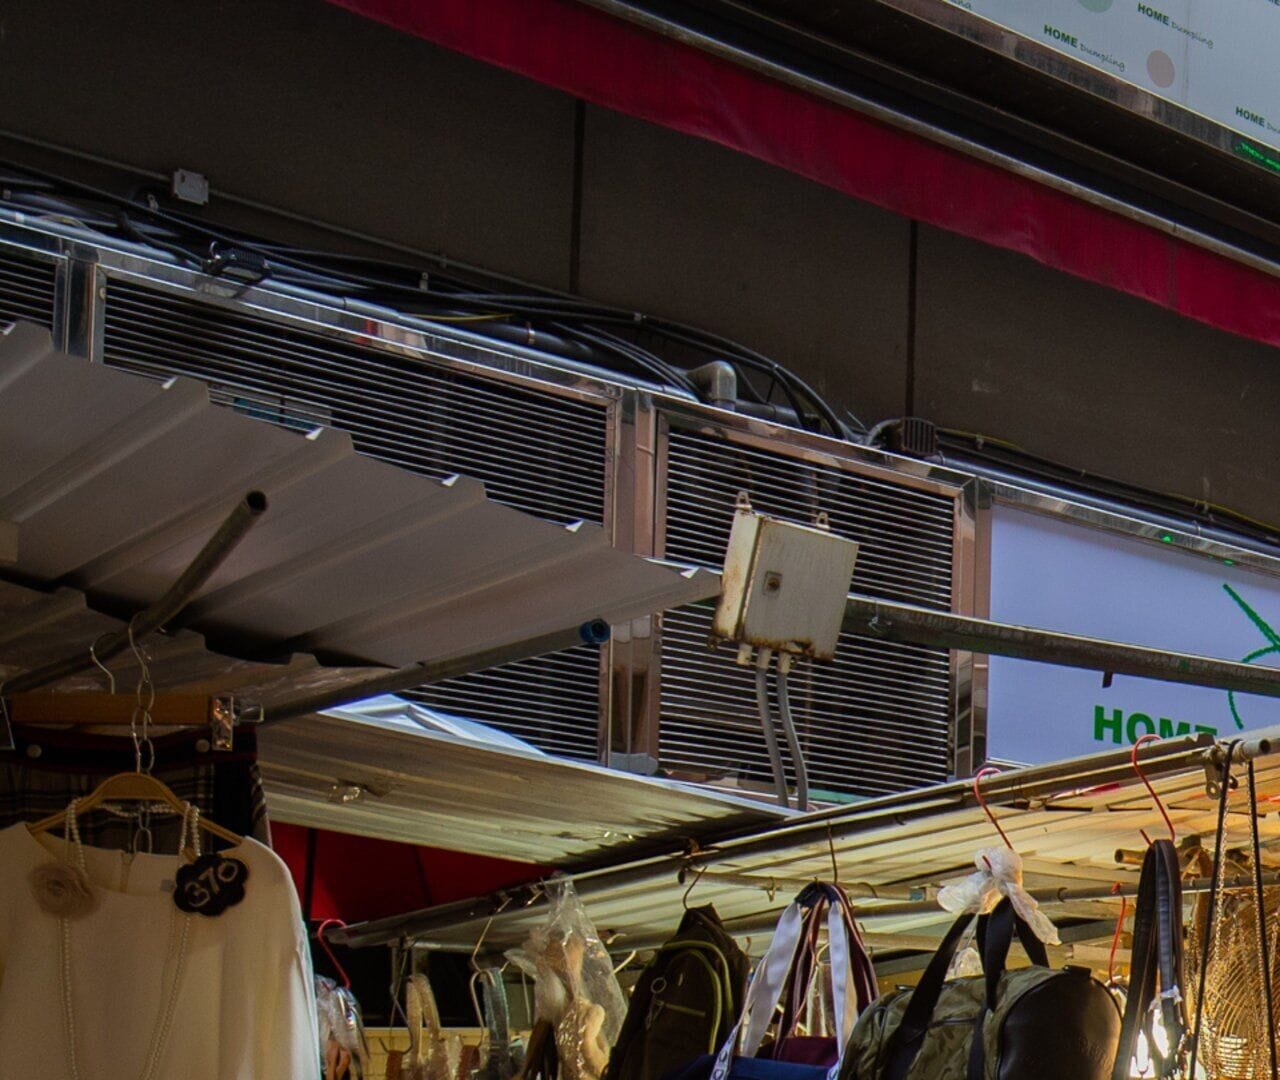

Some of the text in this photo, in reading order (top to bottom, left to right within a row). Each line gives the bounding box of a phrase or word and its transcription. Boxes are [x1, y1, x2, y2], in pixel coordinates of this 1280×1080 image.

[1138, 3, 1169, 26] HOME
[1044, 24, 1125, 72] HOME Dumpling
[1235, 106, 1265, 127] HOME
